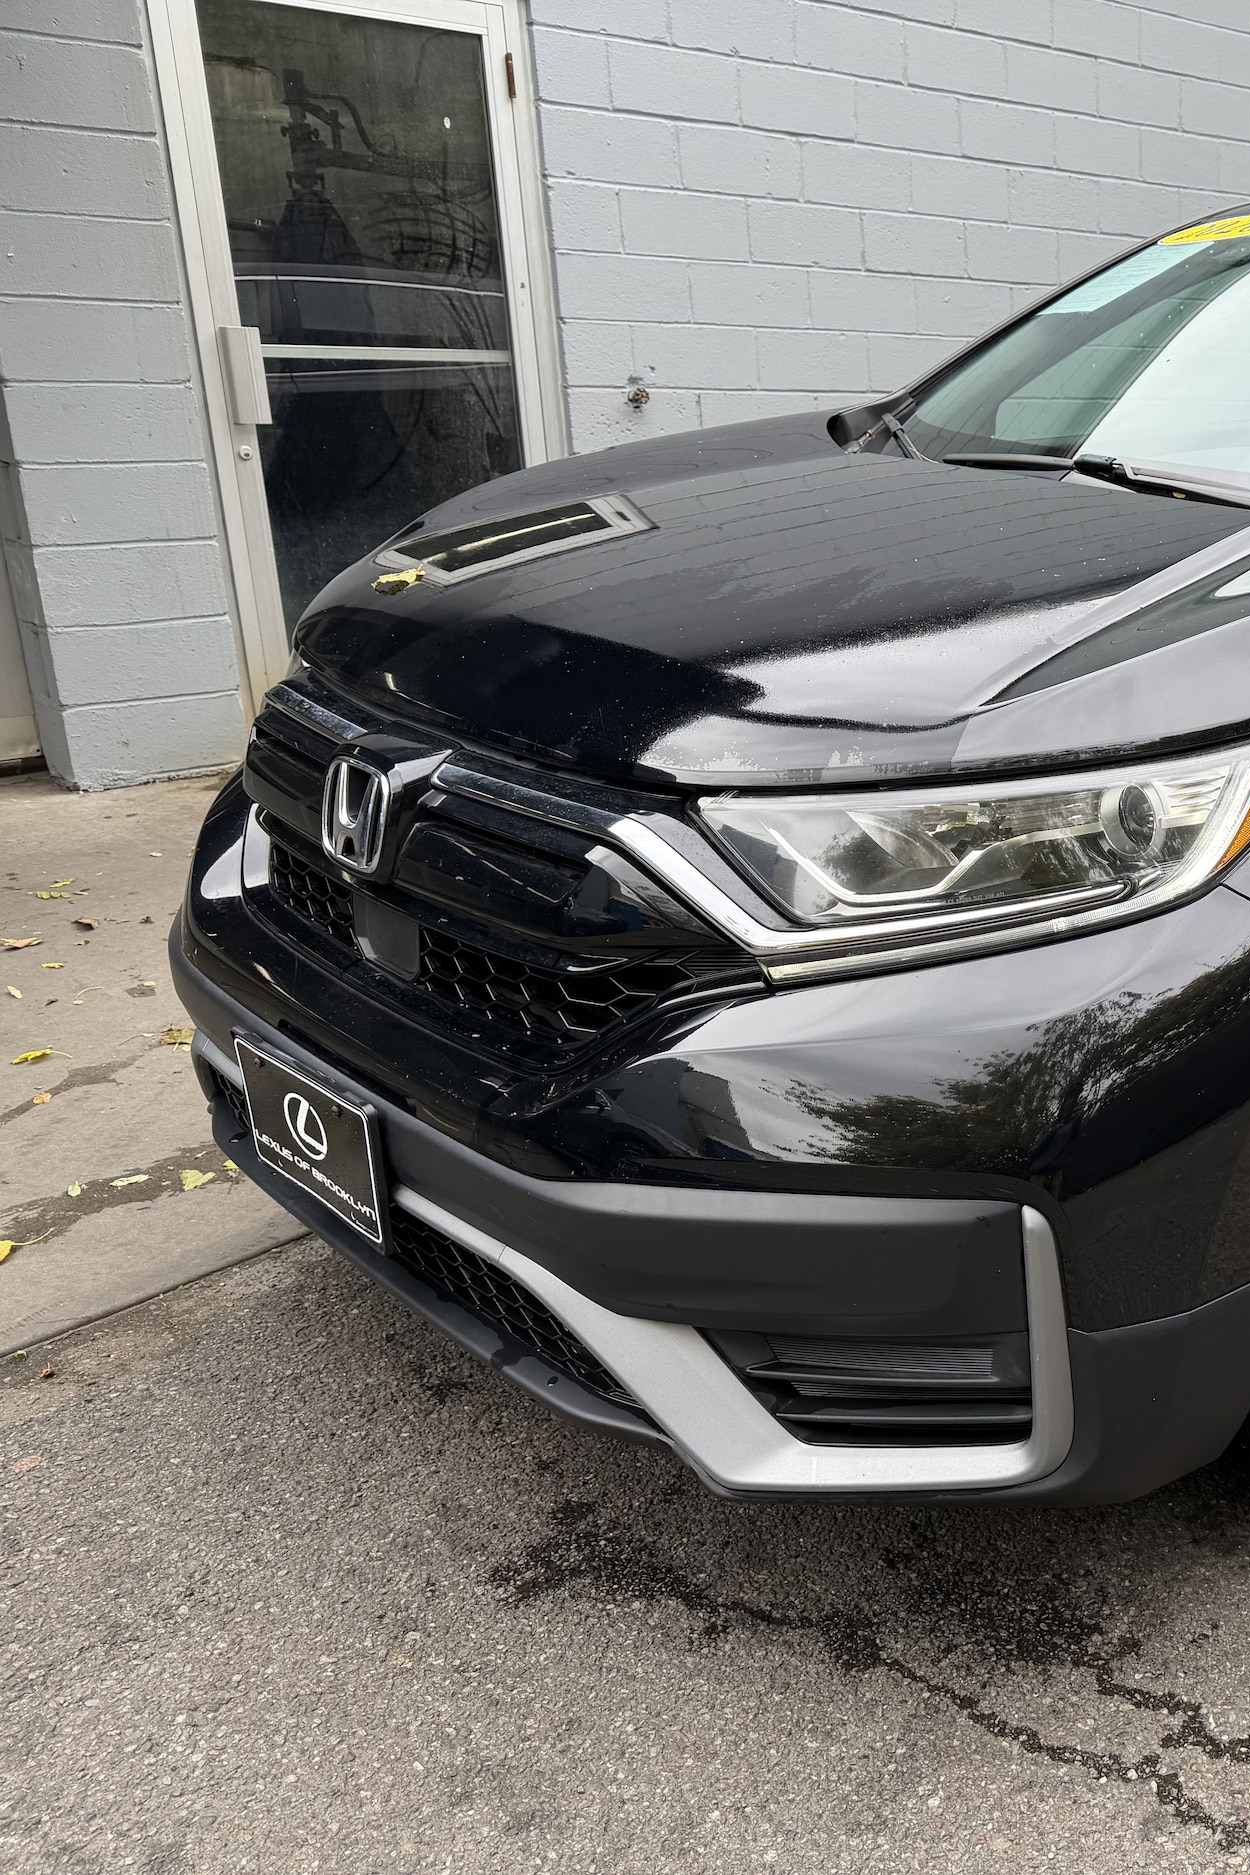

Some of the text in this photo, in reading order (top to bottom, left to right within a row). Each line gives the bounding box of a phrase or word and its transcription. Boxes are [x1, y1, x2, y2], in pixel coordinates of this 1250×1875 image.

[254, 1128, 376, 1221] LEXUS OF BROOKLYN
